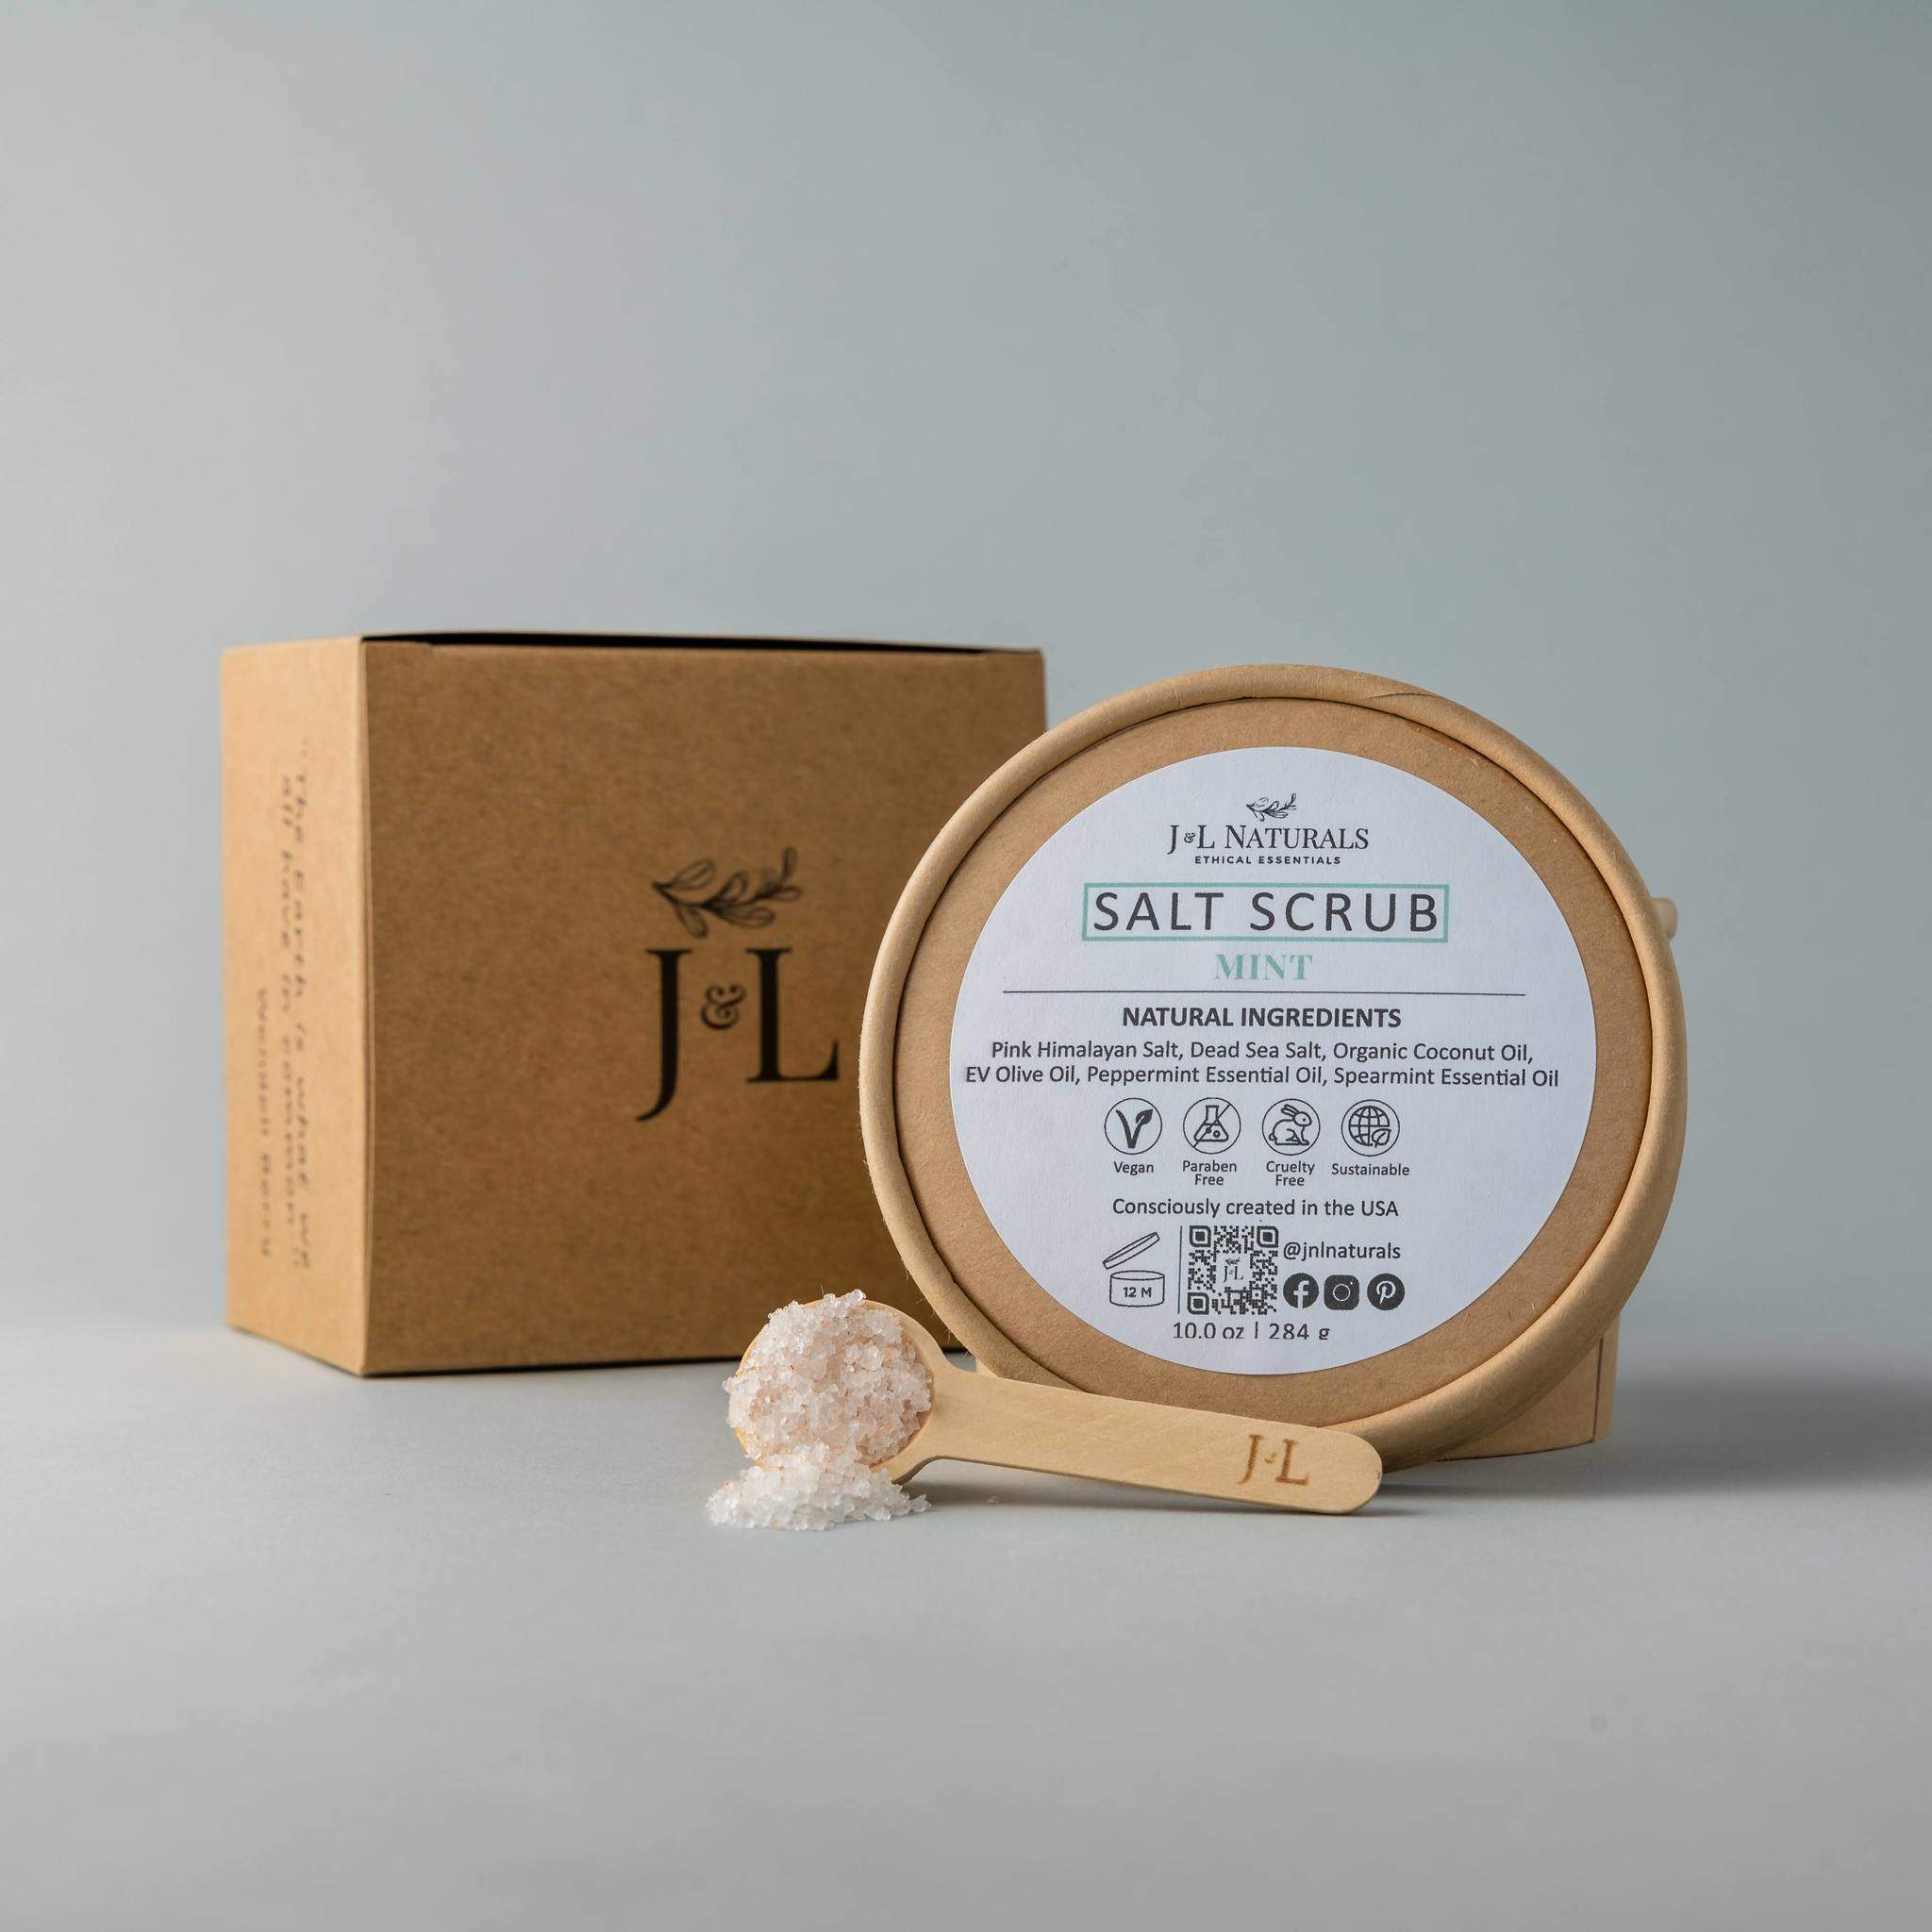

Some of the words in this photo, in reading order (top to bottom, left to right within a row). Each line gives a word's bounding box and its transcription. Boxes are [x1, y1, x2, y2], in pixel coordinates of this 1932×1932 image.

[1166, 824, 1217, 855] J&L
[1224, 824, 1370, 850] NATURALS
[1194, 854, 1252, 865] ETHICAL
[1257, 855, 1341, 866] ESSENTIALS
[1093, 891, 1224, 931] SALT
[1249, 891, 1438, 933] SCRUB
[1213, 953, 1314, 981] MINT
[1122, 1007, 1235, 1027] NATURAL
[1241, 1007, 1403, 1028] INGREDIENTS
[635, 947, 840, 1123] J&L
[991, 1040, 1032, 1059] Pink
[1037, 1040, 1138, 1062] Himalayan
[1142, 1040, 1184, 1061] Salt,
[1191, 1041, 1240, 1058] Dead
[1245, 1041, 1279, 1059] Sea
[1285, 1041, 1326, 1062] Salt,
[1333, 1041, 1408, 1064] Organic
[1412, 1042, 1496, 1062] Coconut
[1500, 1043, 1534, 1065] Oil,
[965, 1065, 991, 1084] EV
[995, 1064, 1044, 1083] Olive
[1049, 1064, 1081, 1087] Oil,
[1087, 1065, 1200, 1087] Peppermint
[1206, 1065, 1291, 1084] Essential
[1295, 1065, 1328, 1088] Oil,
[1333, 1066, 1436, 1089] Spearmint
[1441, 1068, 1526, 1087] Essential
[1531, 1069, 1559, 1088] Oil
[1113, 1160, 1155, 1176] Vegan
[1182, 1158, 1238, 1173] Paraben
[1265, 1159, 1316, 1176] Cruelty
[1331, 1162, 1410, 1176] Sustainable
[1194, 1173, 1224, 1187] Free
[1274, 1174, 1306, 1187] Free
[1112, 1197, 1222, 1220] Consciously
[1225, 1198, 1295, 1216] created
[1323, 1198, 1356, 1217] the
[1360, 1199, 1400, 1217] USA
[1283, 1241, 1402, 1262] @jnlnaturals
[1123, 1286, 1138, 1299] 12
[1141, 1286, 1153, 1298] M
[1173, 1322, 1217, 1340] 10.0
[1222, 1326, 1245, 1341] oz
[1268, 1322, 1310, 1341] 284
